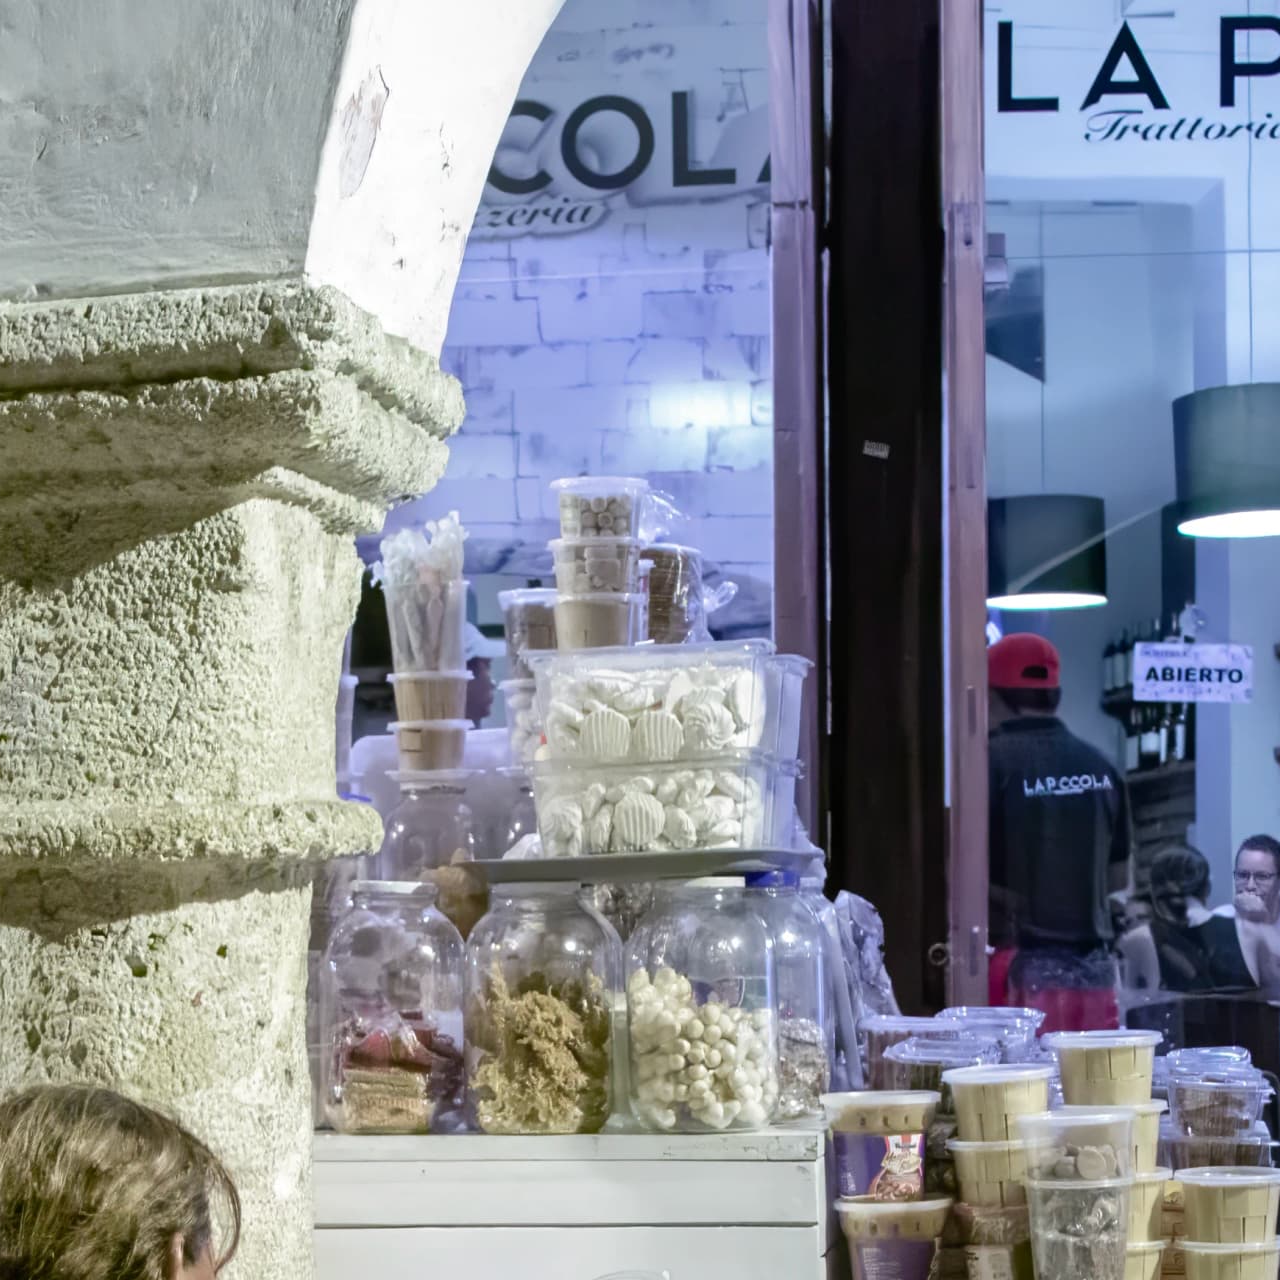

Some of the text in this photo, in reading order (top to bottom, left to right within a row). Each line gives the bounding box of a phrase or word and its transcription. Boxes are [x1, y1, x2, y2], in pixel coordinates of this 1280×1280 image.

[997, 20, 1170, 113] LA
[487, 91, 771, 194] COL
[1145, 666, 1244, 684] ABIERTO
